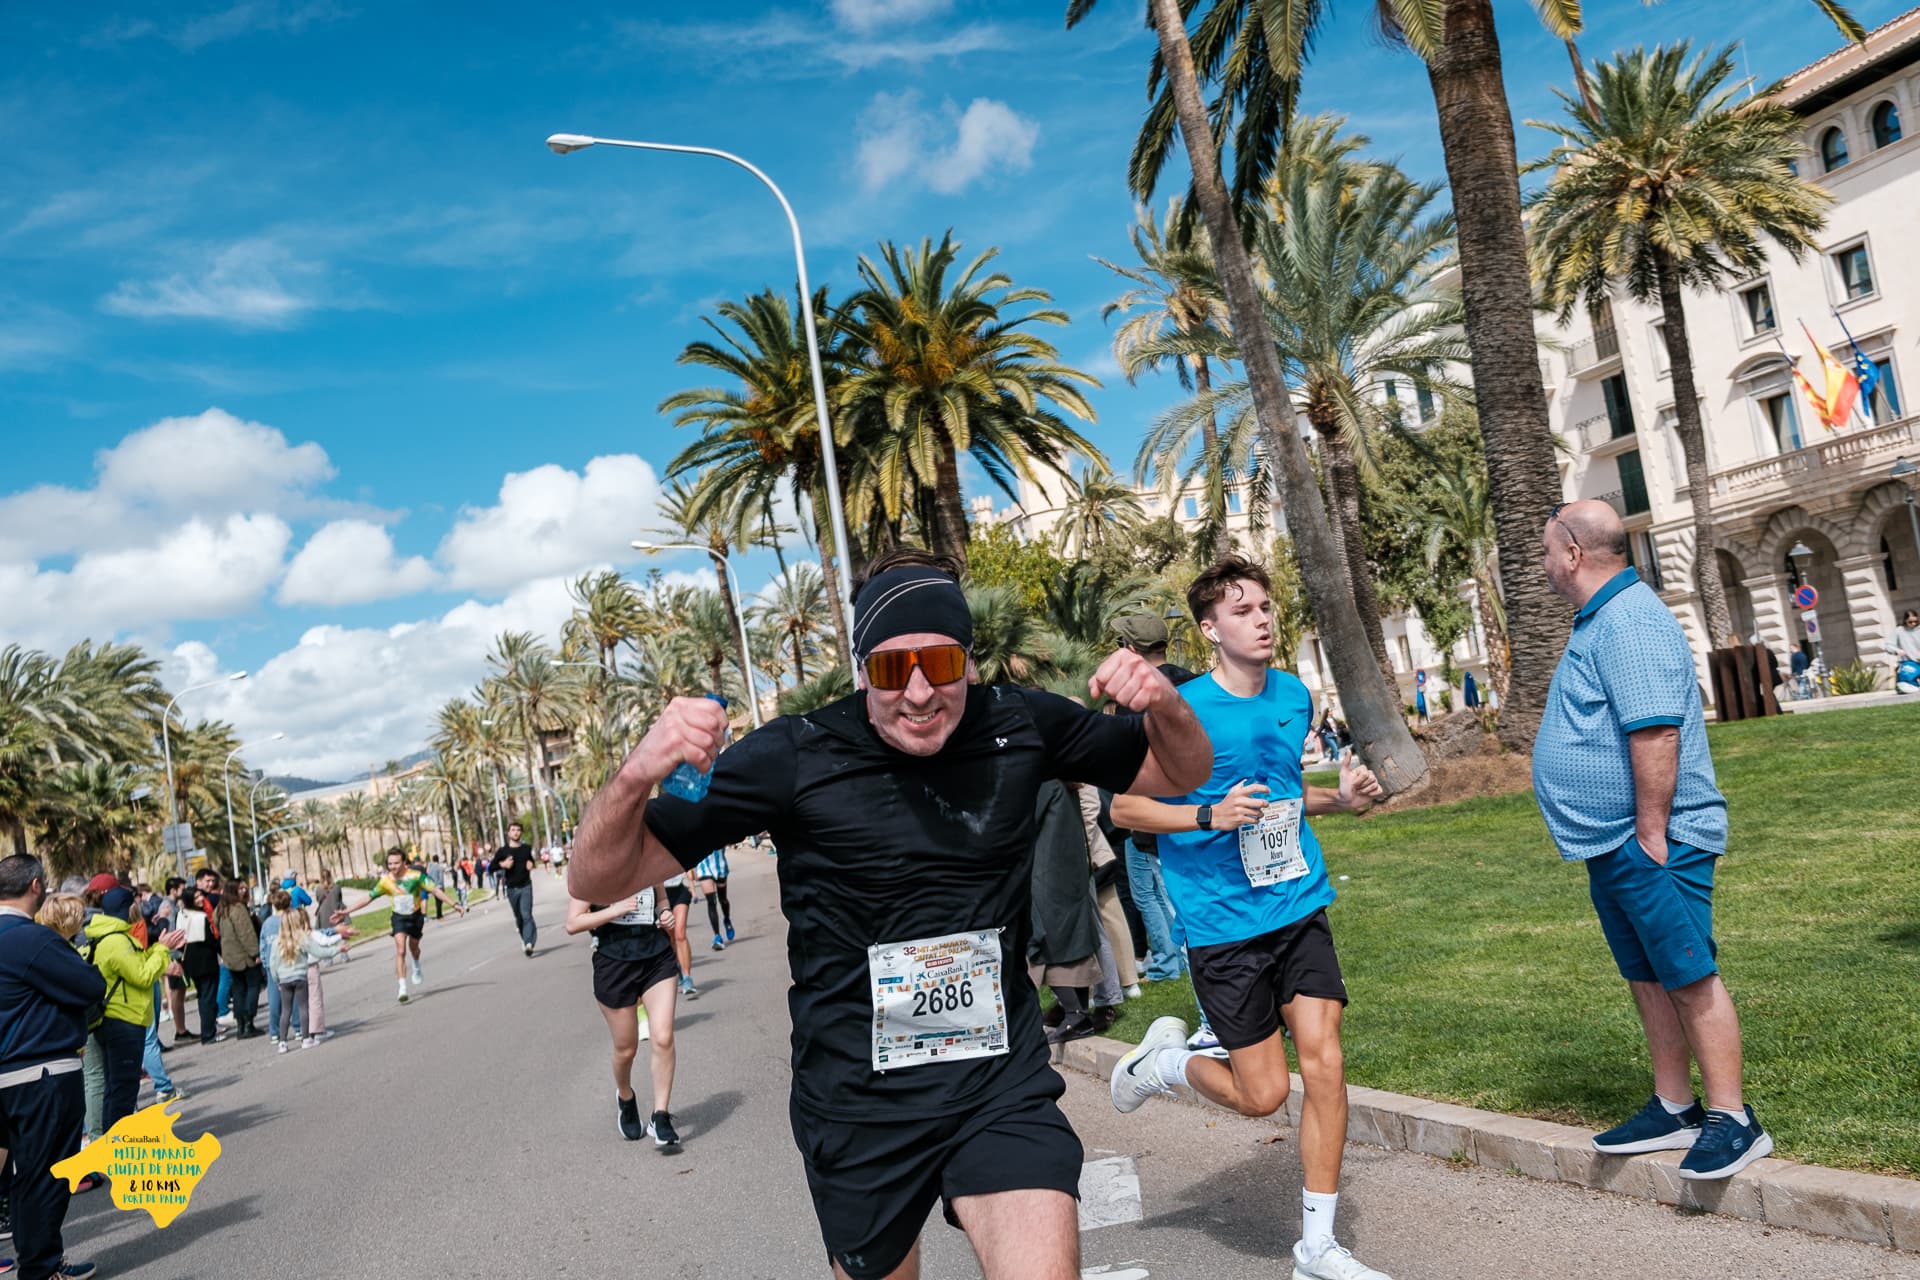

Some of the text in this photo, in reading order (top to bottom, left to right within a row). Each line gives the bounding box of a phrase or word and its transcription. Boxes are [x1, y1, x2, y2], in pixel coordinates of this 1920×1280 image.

[1260, 830, 1288, 850] 1097
[903, 946, 916, 956] 32
[927, 965, 964, 978] CaixaBank
[912, 980, 974, 1018] 2686
